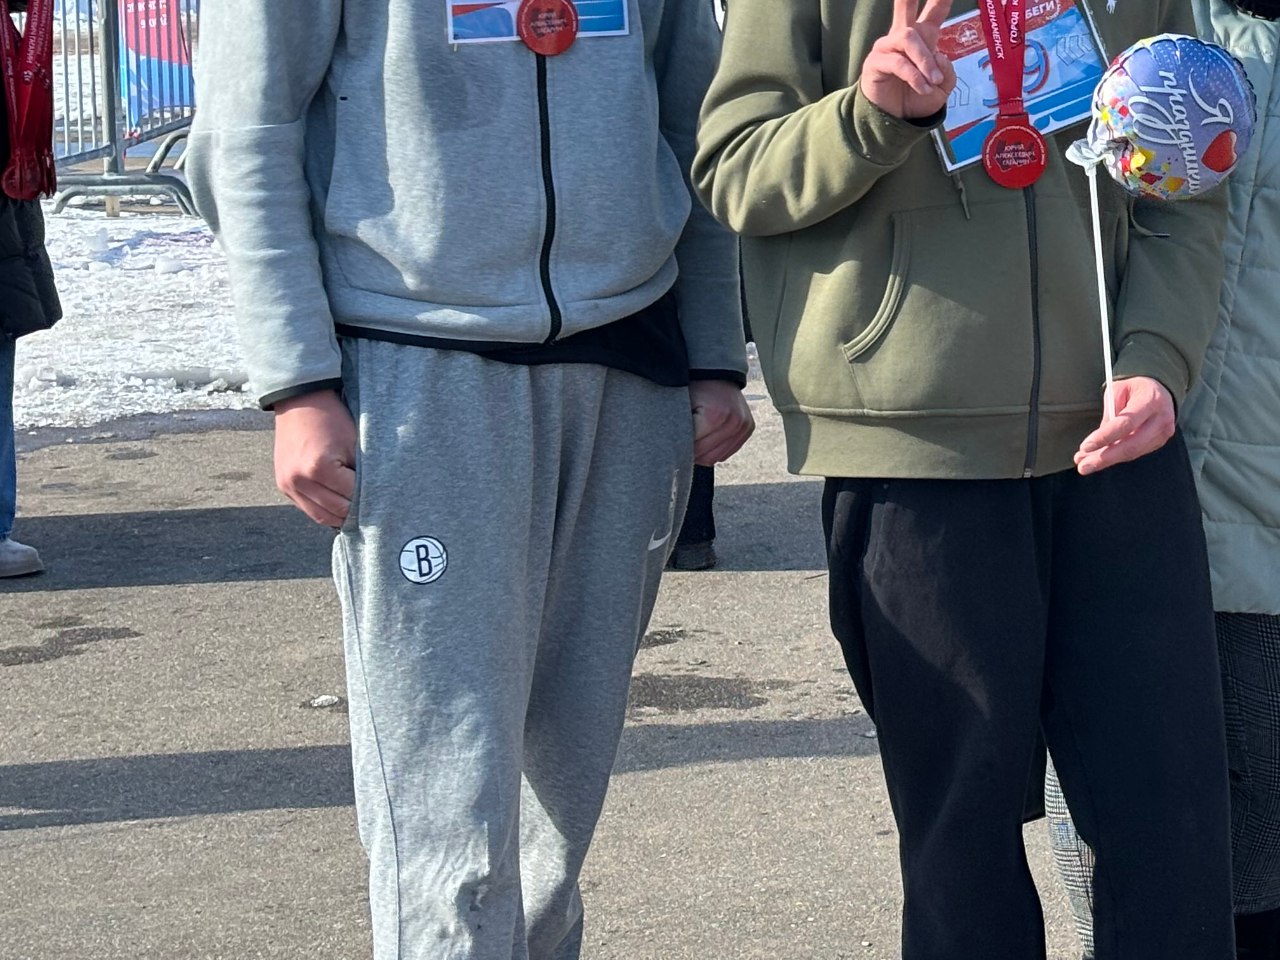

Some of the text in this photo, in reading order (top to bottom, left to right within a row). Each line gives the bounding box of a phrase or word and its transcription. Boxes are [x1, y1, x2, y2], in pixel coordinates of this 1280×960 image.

[1025, 1, 1055, 19] БЕГИ
[1010, 11, 1019, 44] ГОРОД
[1189, 68, 1234, 126] Я
[1128, 70, 1200, 194] праздники
[415, 544, 433, 578] B
